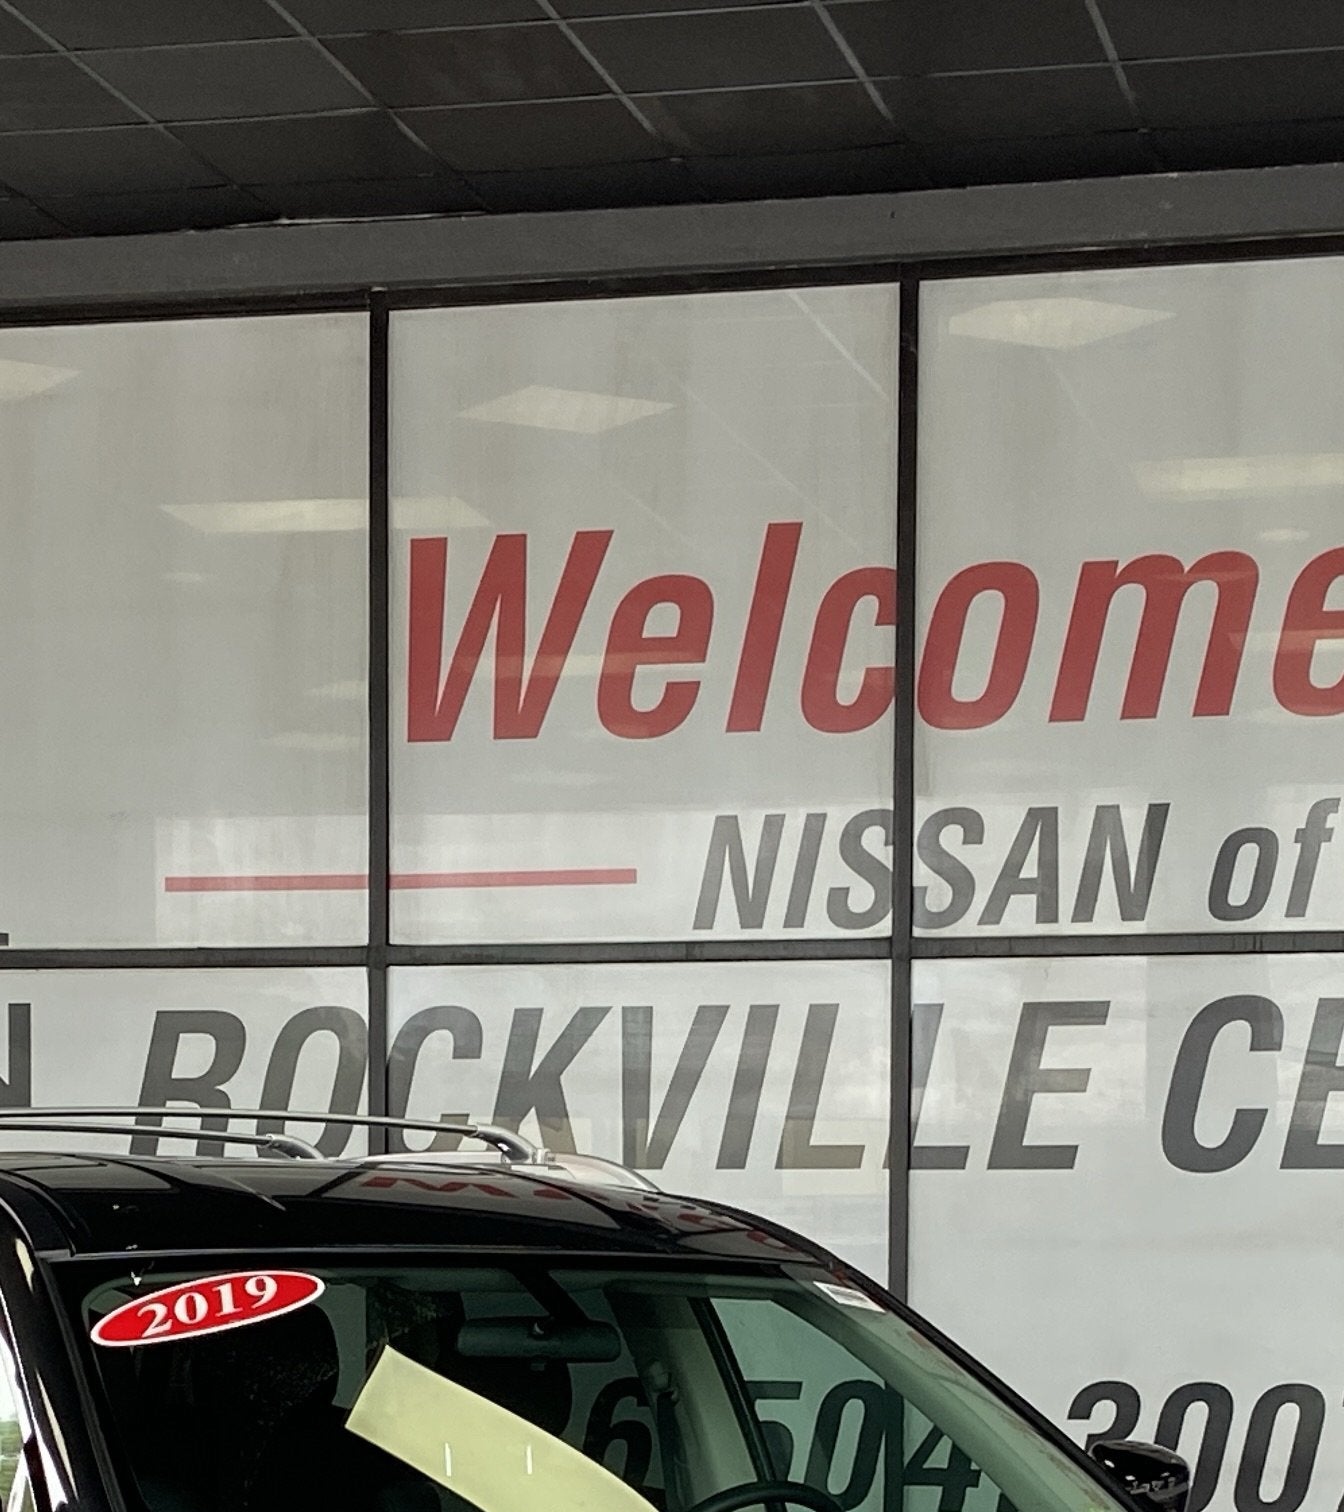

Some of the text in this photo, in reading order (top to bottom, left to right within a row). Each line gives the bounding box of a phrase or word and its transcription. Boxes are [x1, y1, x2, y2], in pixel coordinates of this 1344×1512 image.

[691, 797, 1342, 933] NISSAN of
[129, 1000, 1111, 1172] ROCKVILLE
[139, 1274, 277, 1338] 2019
